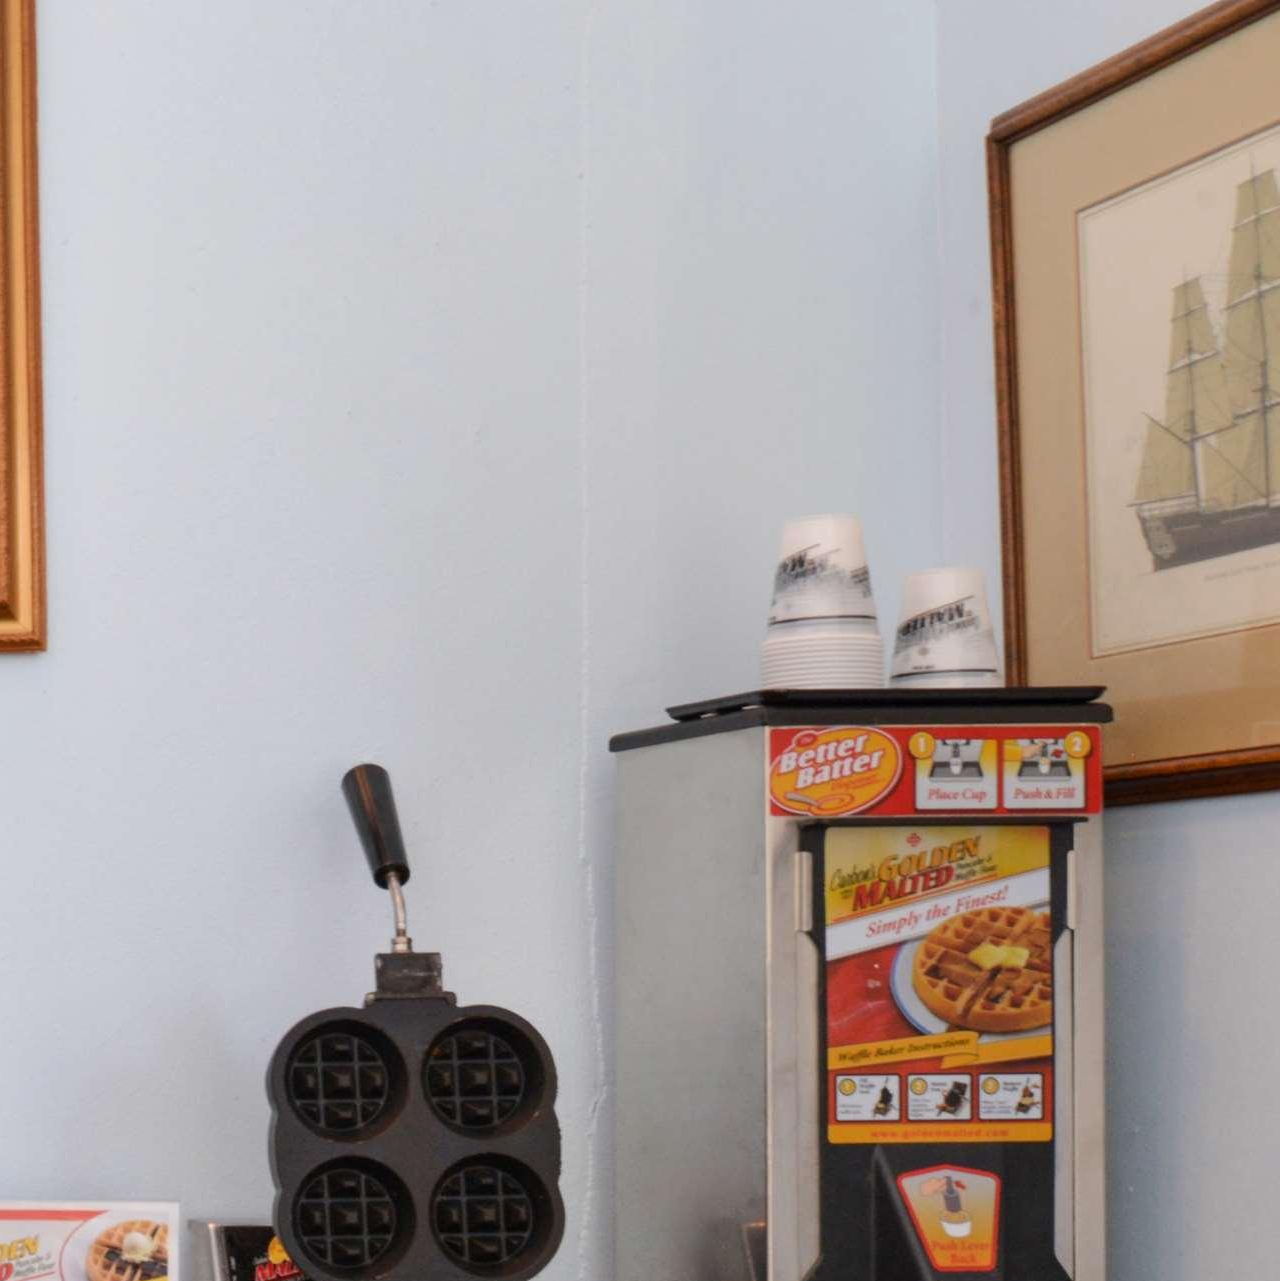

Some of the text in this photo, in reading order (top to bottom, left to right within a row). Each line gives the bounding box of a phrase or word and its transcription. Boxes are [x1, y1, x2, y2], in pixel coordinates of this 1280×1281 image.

[779, 734, 870, 774] Better
[918, 737, 926, 752] 1
[1071, 737, 1082, 752] 2
[796, 749, 884, 788] Batter
[928, 787, 987, 803] Place Cup
[1014, 786, 1042, 800] Push
[1055, 786, 1076, 800] Fill
[878, 835, 981, 882] GOLDEN
[852, 864, 956, 912] MALTED
[865, 884, 1009, 939] Simply the Finest!
